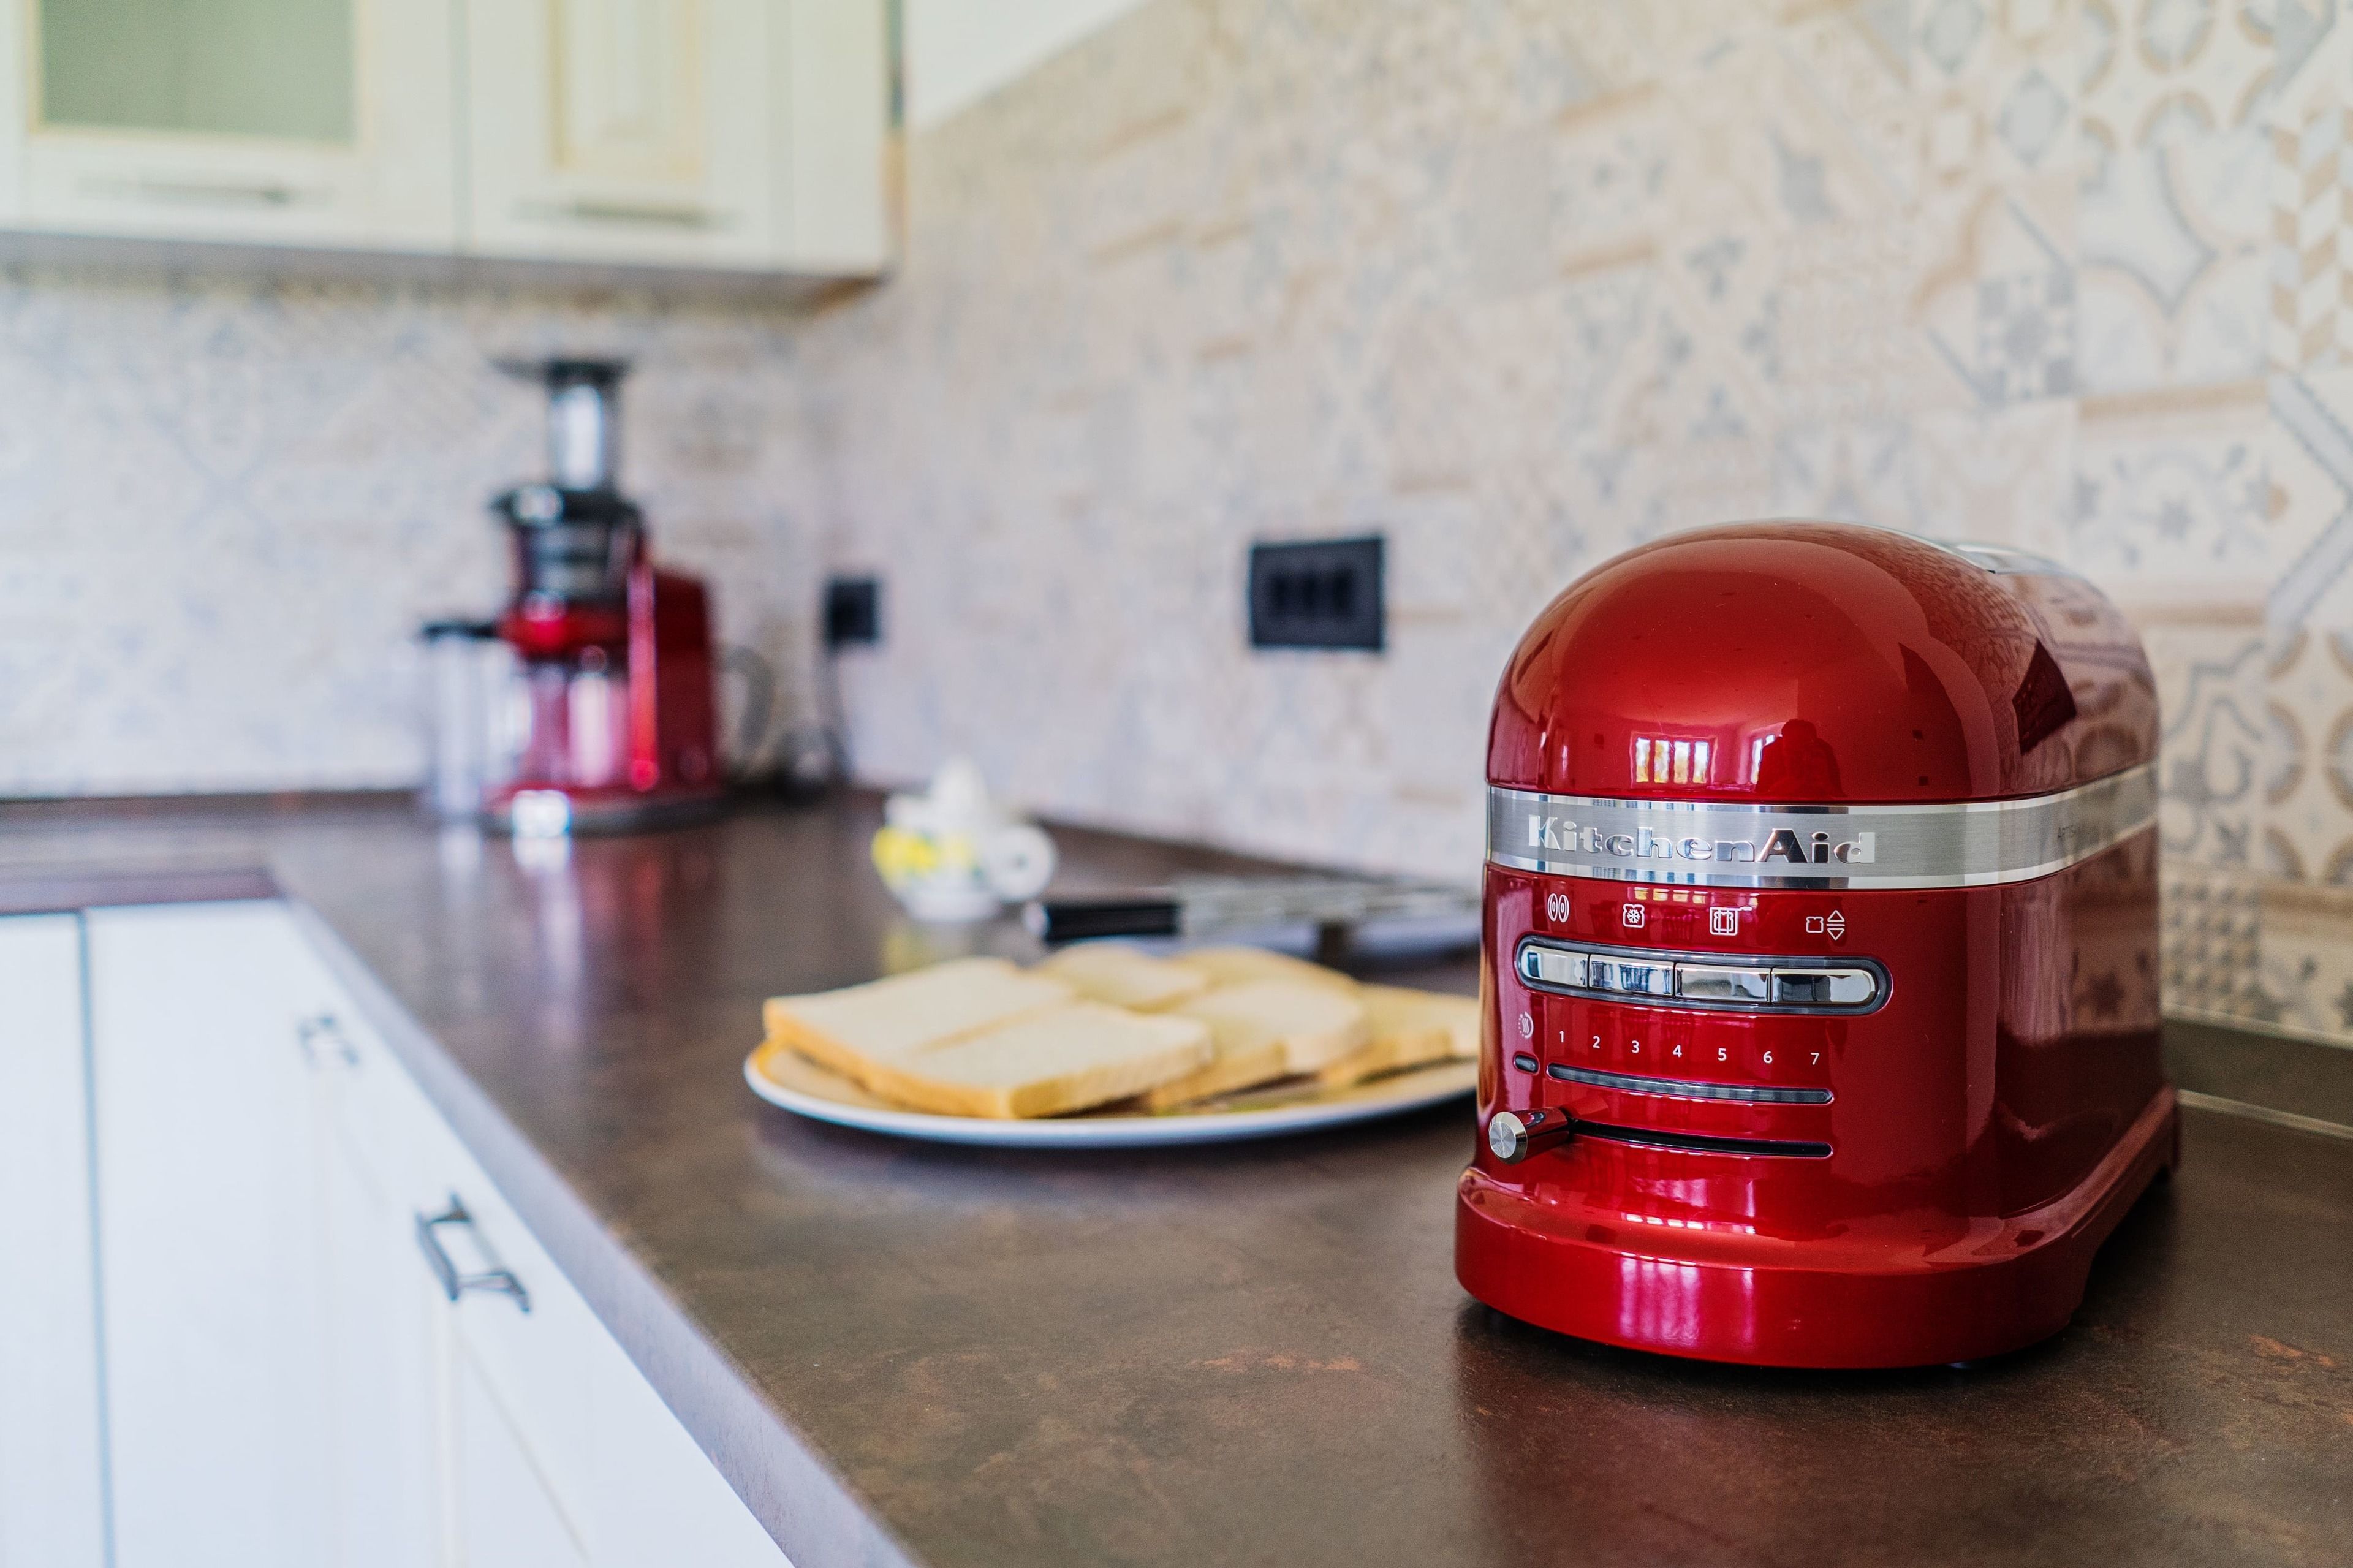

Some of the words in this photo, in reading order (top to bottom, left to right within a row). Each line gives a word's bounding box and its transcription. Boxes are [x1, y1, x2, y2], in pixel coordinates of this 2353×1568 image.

[1528, 814, 1876, 863] KitchenAid
[1559, 1031, 1564, 1043] 1
[1593, 1036, 1601, 1048] 2
[1631, 1040, 1640, 1054] 3
[1672, 1044, 1683, 1058] 4
[1718, 1048, 1727, 1061] 5
[1763, 1050, 1773, 1064] 6
[1810, 1052, 1819, 1065] 7
